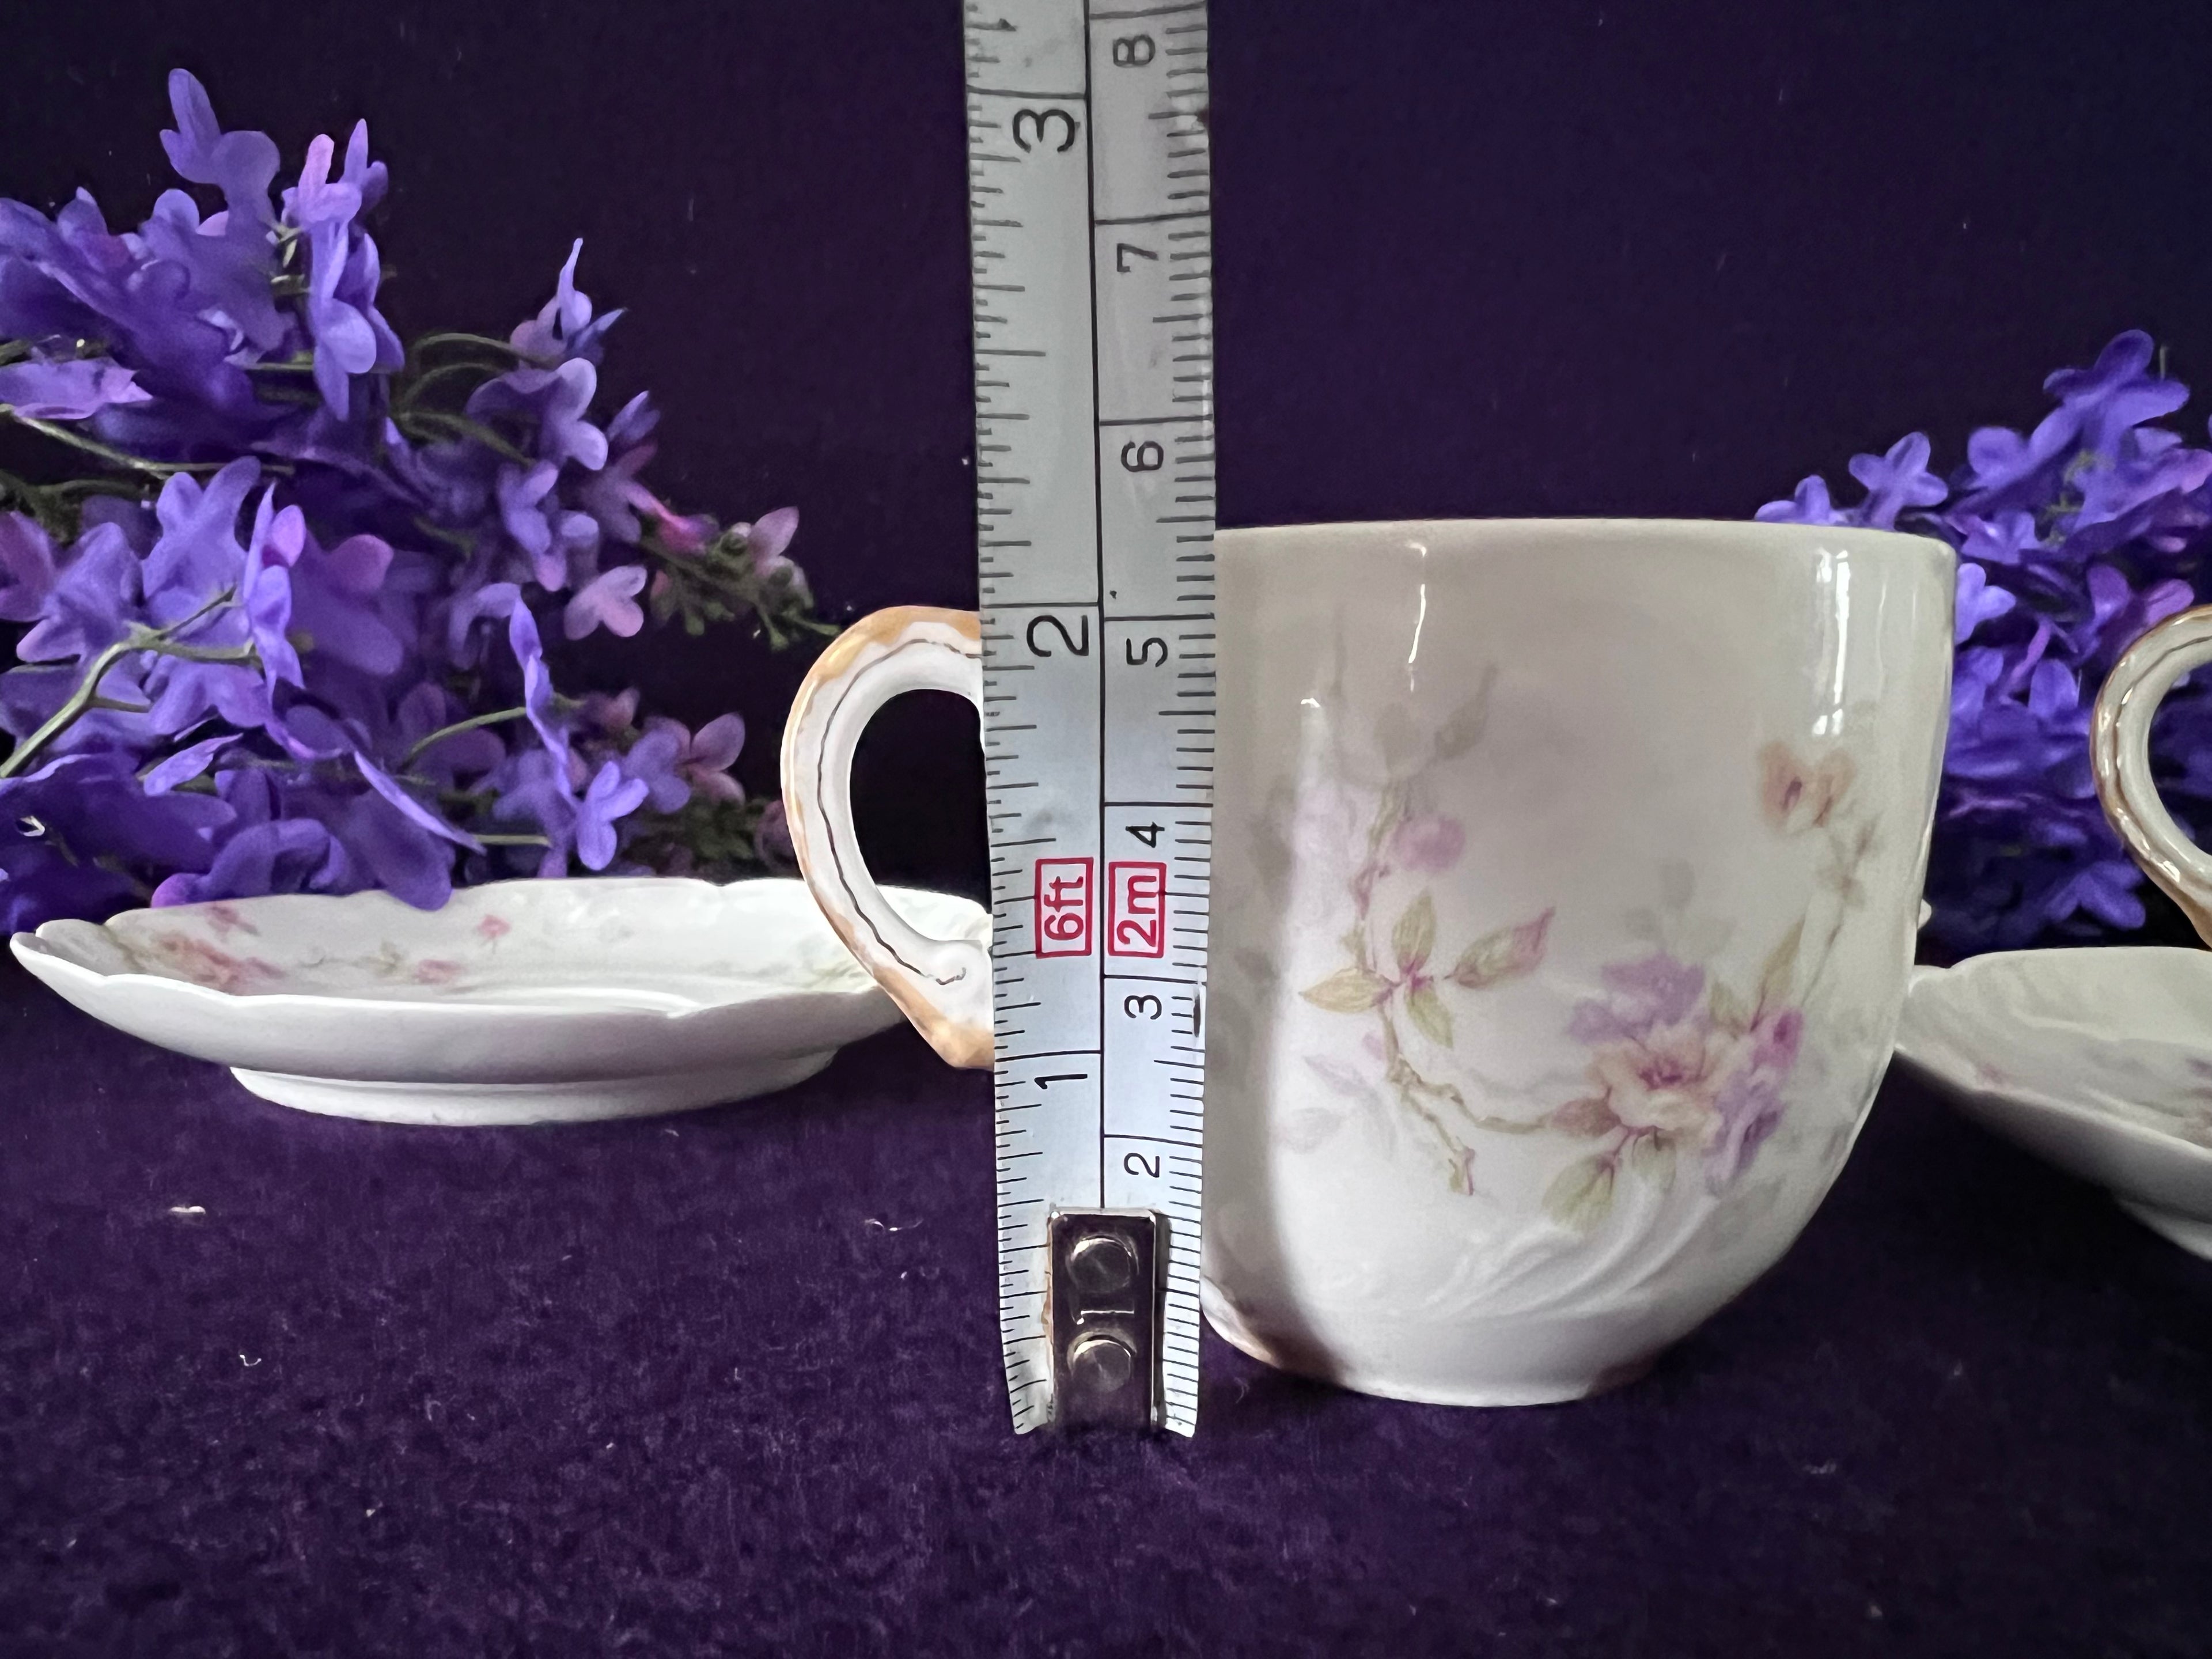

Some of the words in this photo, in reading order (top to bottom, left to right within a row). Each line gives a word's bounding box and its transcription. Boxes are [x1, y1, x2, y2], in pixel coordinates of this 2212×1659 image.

[1113, 34, 1156, 68] 8
[1012, 108, 1076, 153] 3
[1116, 243, 1159, 273] 7
[1120, 440, 1164, 472] 6
[1027, 615, 1089, 657] 2
[1126, 637, 1168, 667] 5
[1125, 821, 1165, 848] 4
[1043, 876, 1084, 941] 6ft
[1116, 874, 1157, 948] 2m
[1124, 994, 1162, 1020] 3
[1034, 1073, 1088, 1090] 1
[1124, 1152, 1160, 1179] 2
